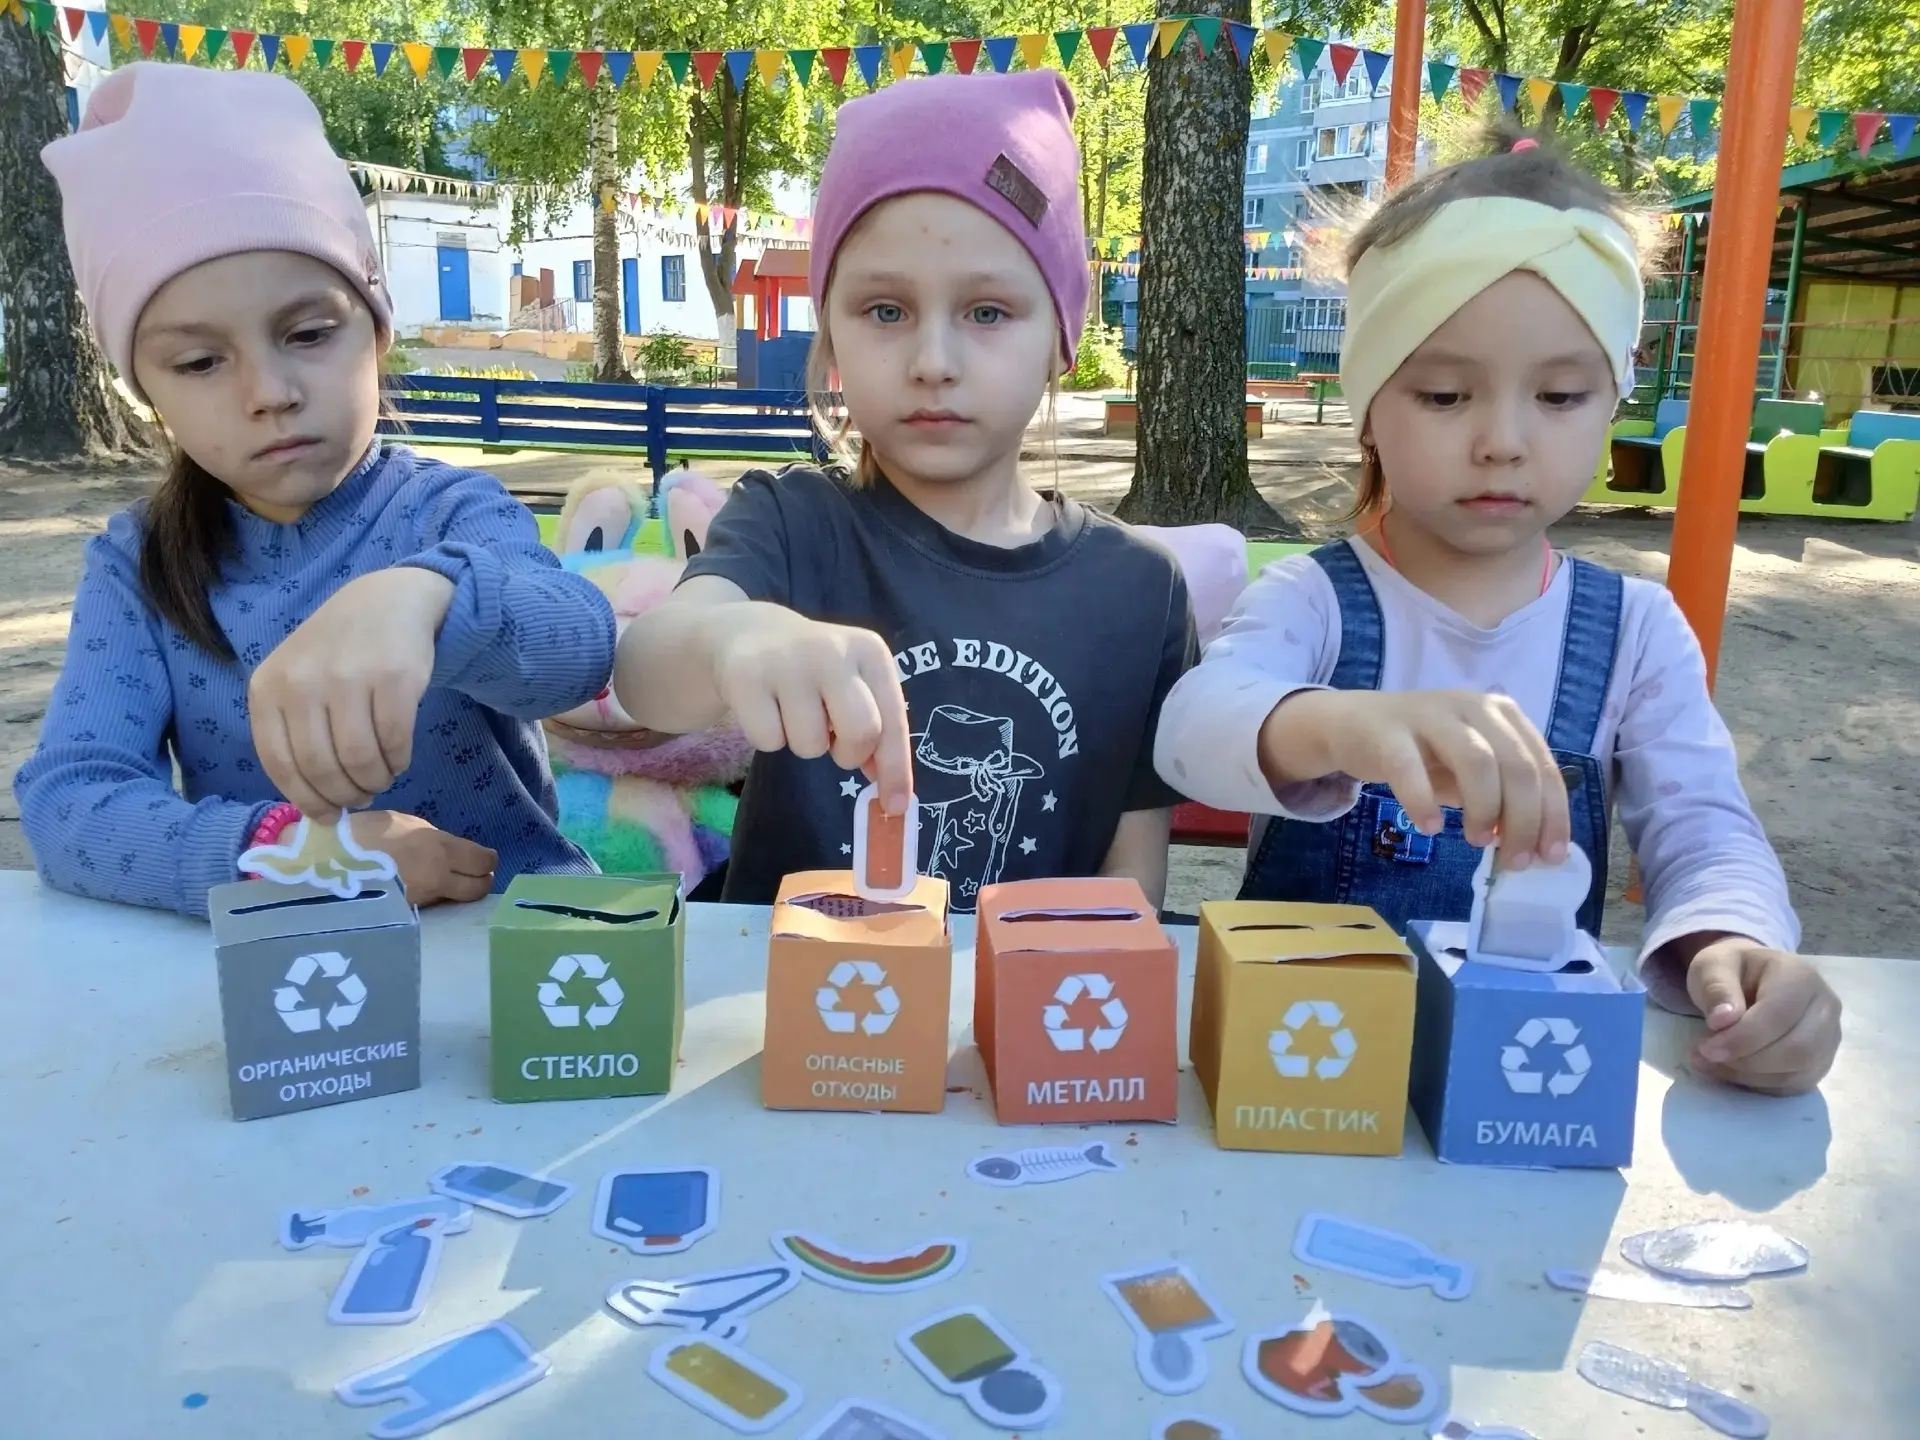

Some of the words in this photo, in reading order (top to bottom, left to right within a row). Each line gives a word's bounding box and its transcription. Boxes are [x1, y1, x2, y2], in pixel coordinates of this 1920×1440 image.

[893, 640, 941, 684] TE
[951, 638, 1079, 759] EDITION
[239, 1041, 408, 1083] ОРГАНИЧЕСКИЕ
[520, 1053, 640, 1081] СТЕКЛО
[805, 1054, 906, 1074] ОПАСНЫЕ
[279, 1071, 372, 1102] ОТХОДЫ
[811, 1080, 897, 1102] ОТХОДЫ
[1026, 1078, 1145, 1106] МЕТАЛЛ
[1235, 1106, 1380, 1134] ПЛАСТИК
[1476, 1120, 1598, 1149] БУМАГА
